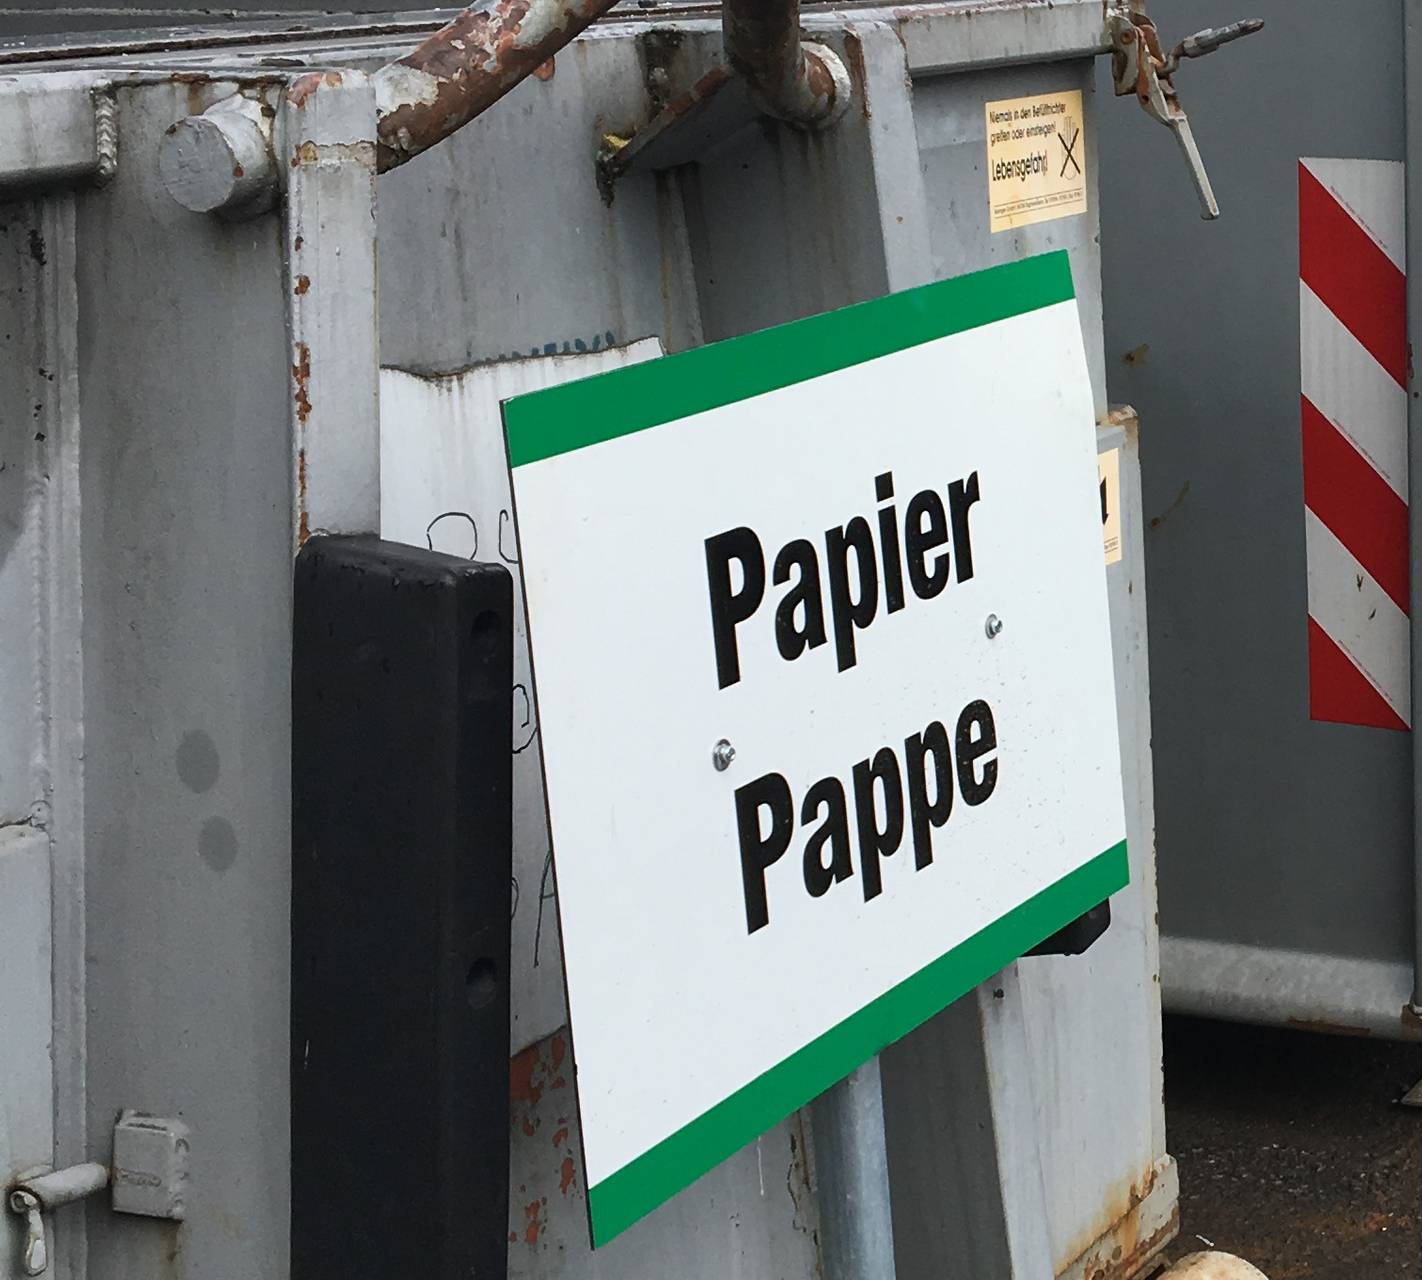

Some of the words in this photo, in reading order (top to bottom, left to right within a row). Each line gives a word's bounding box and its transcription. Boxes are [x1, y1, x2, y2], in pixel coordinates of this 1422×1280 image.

[990, 109, 1012, 123] Niemals
[1020, 107, 1031, 119] den
[991, 129, 1010, 147] greifen
[1012, 128, 1025, 140] oder
[992, 149, 1048, 182] Lebensgefahr!
[704, 471, 981, 690] Papier
[734, 699, 999, 935] Pappe
